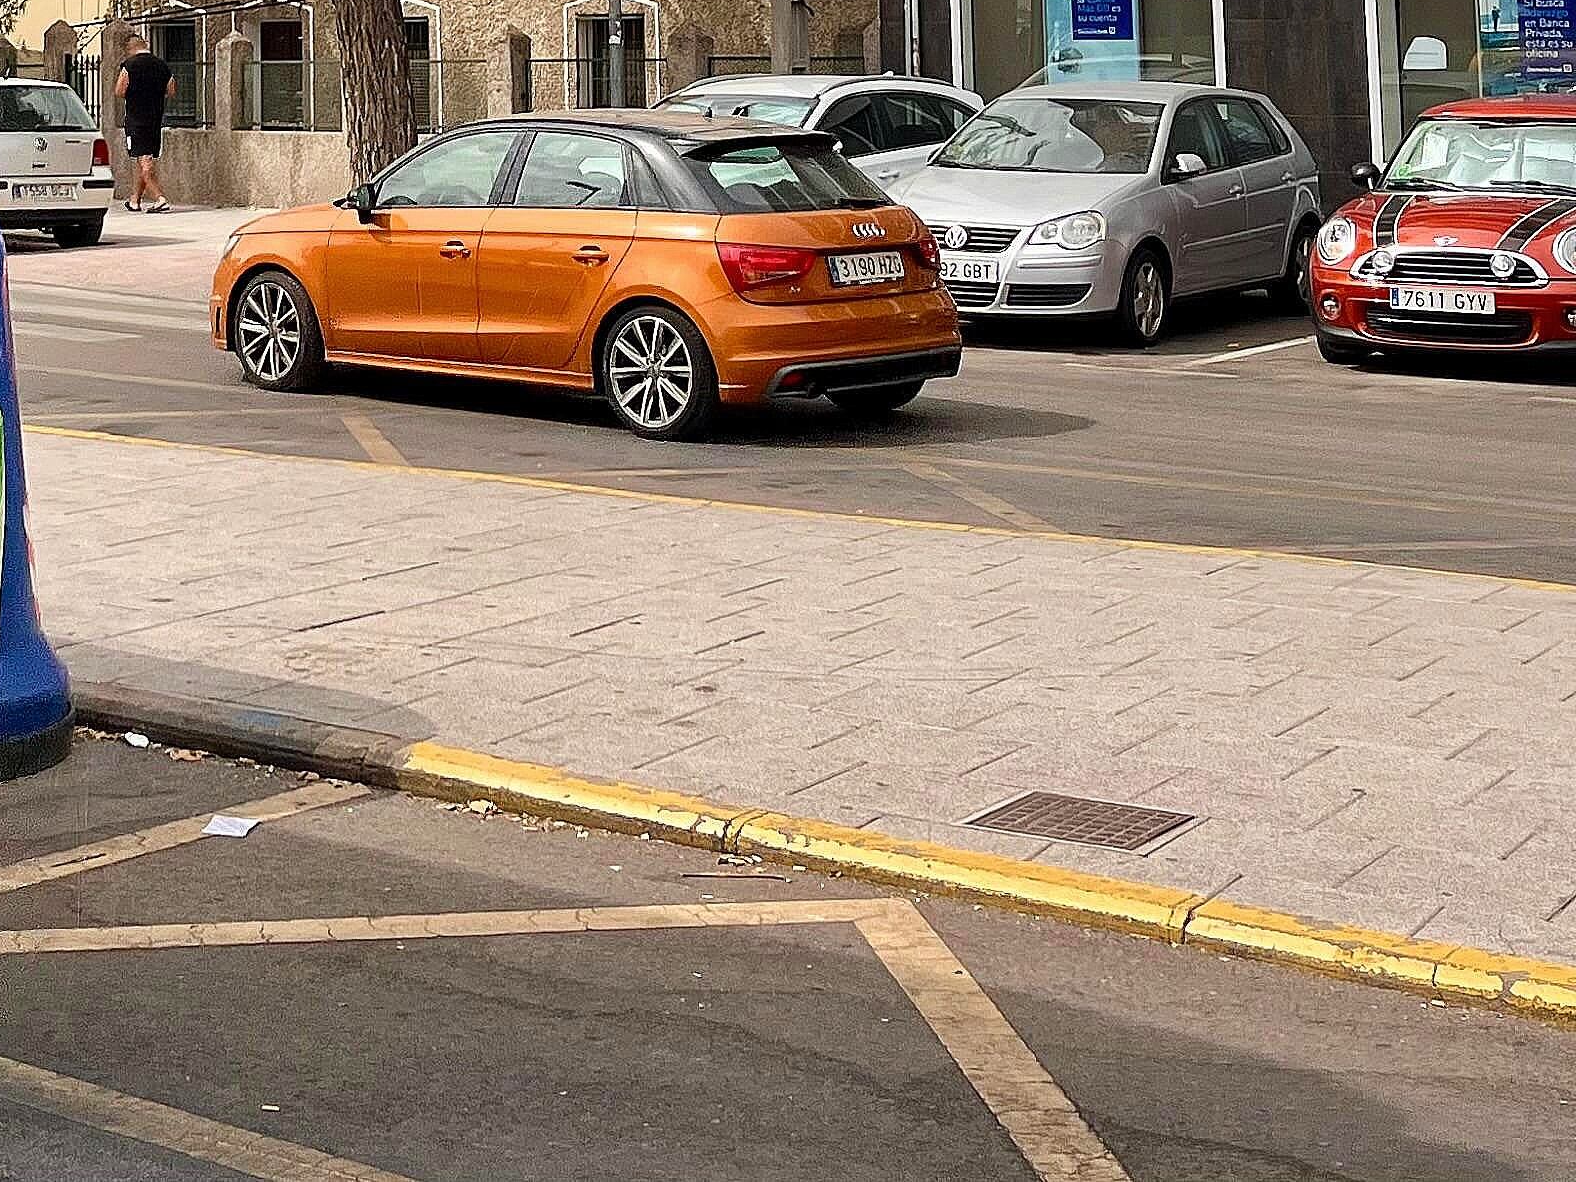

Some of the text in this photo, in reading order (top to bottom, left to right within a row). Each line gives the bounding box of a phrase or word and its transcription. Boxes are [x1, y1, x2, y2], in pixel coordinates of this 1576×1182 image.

[1524, 17, 1570, 28] en Banca
[1560, 40, 1574, 49] su
[1525, 48, 1559, 59] oficina
[839, 256, 875, 278] 3190
[963, 263, 992, 280] GBT
[1404, 290, 1487, 311] 7611 GYV
